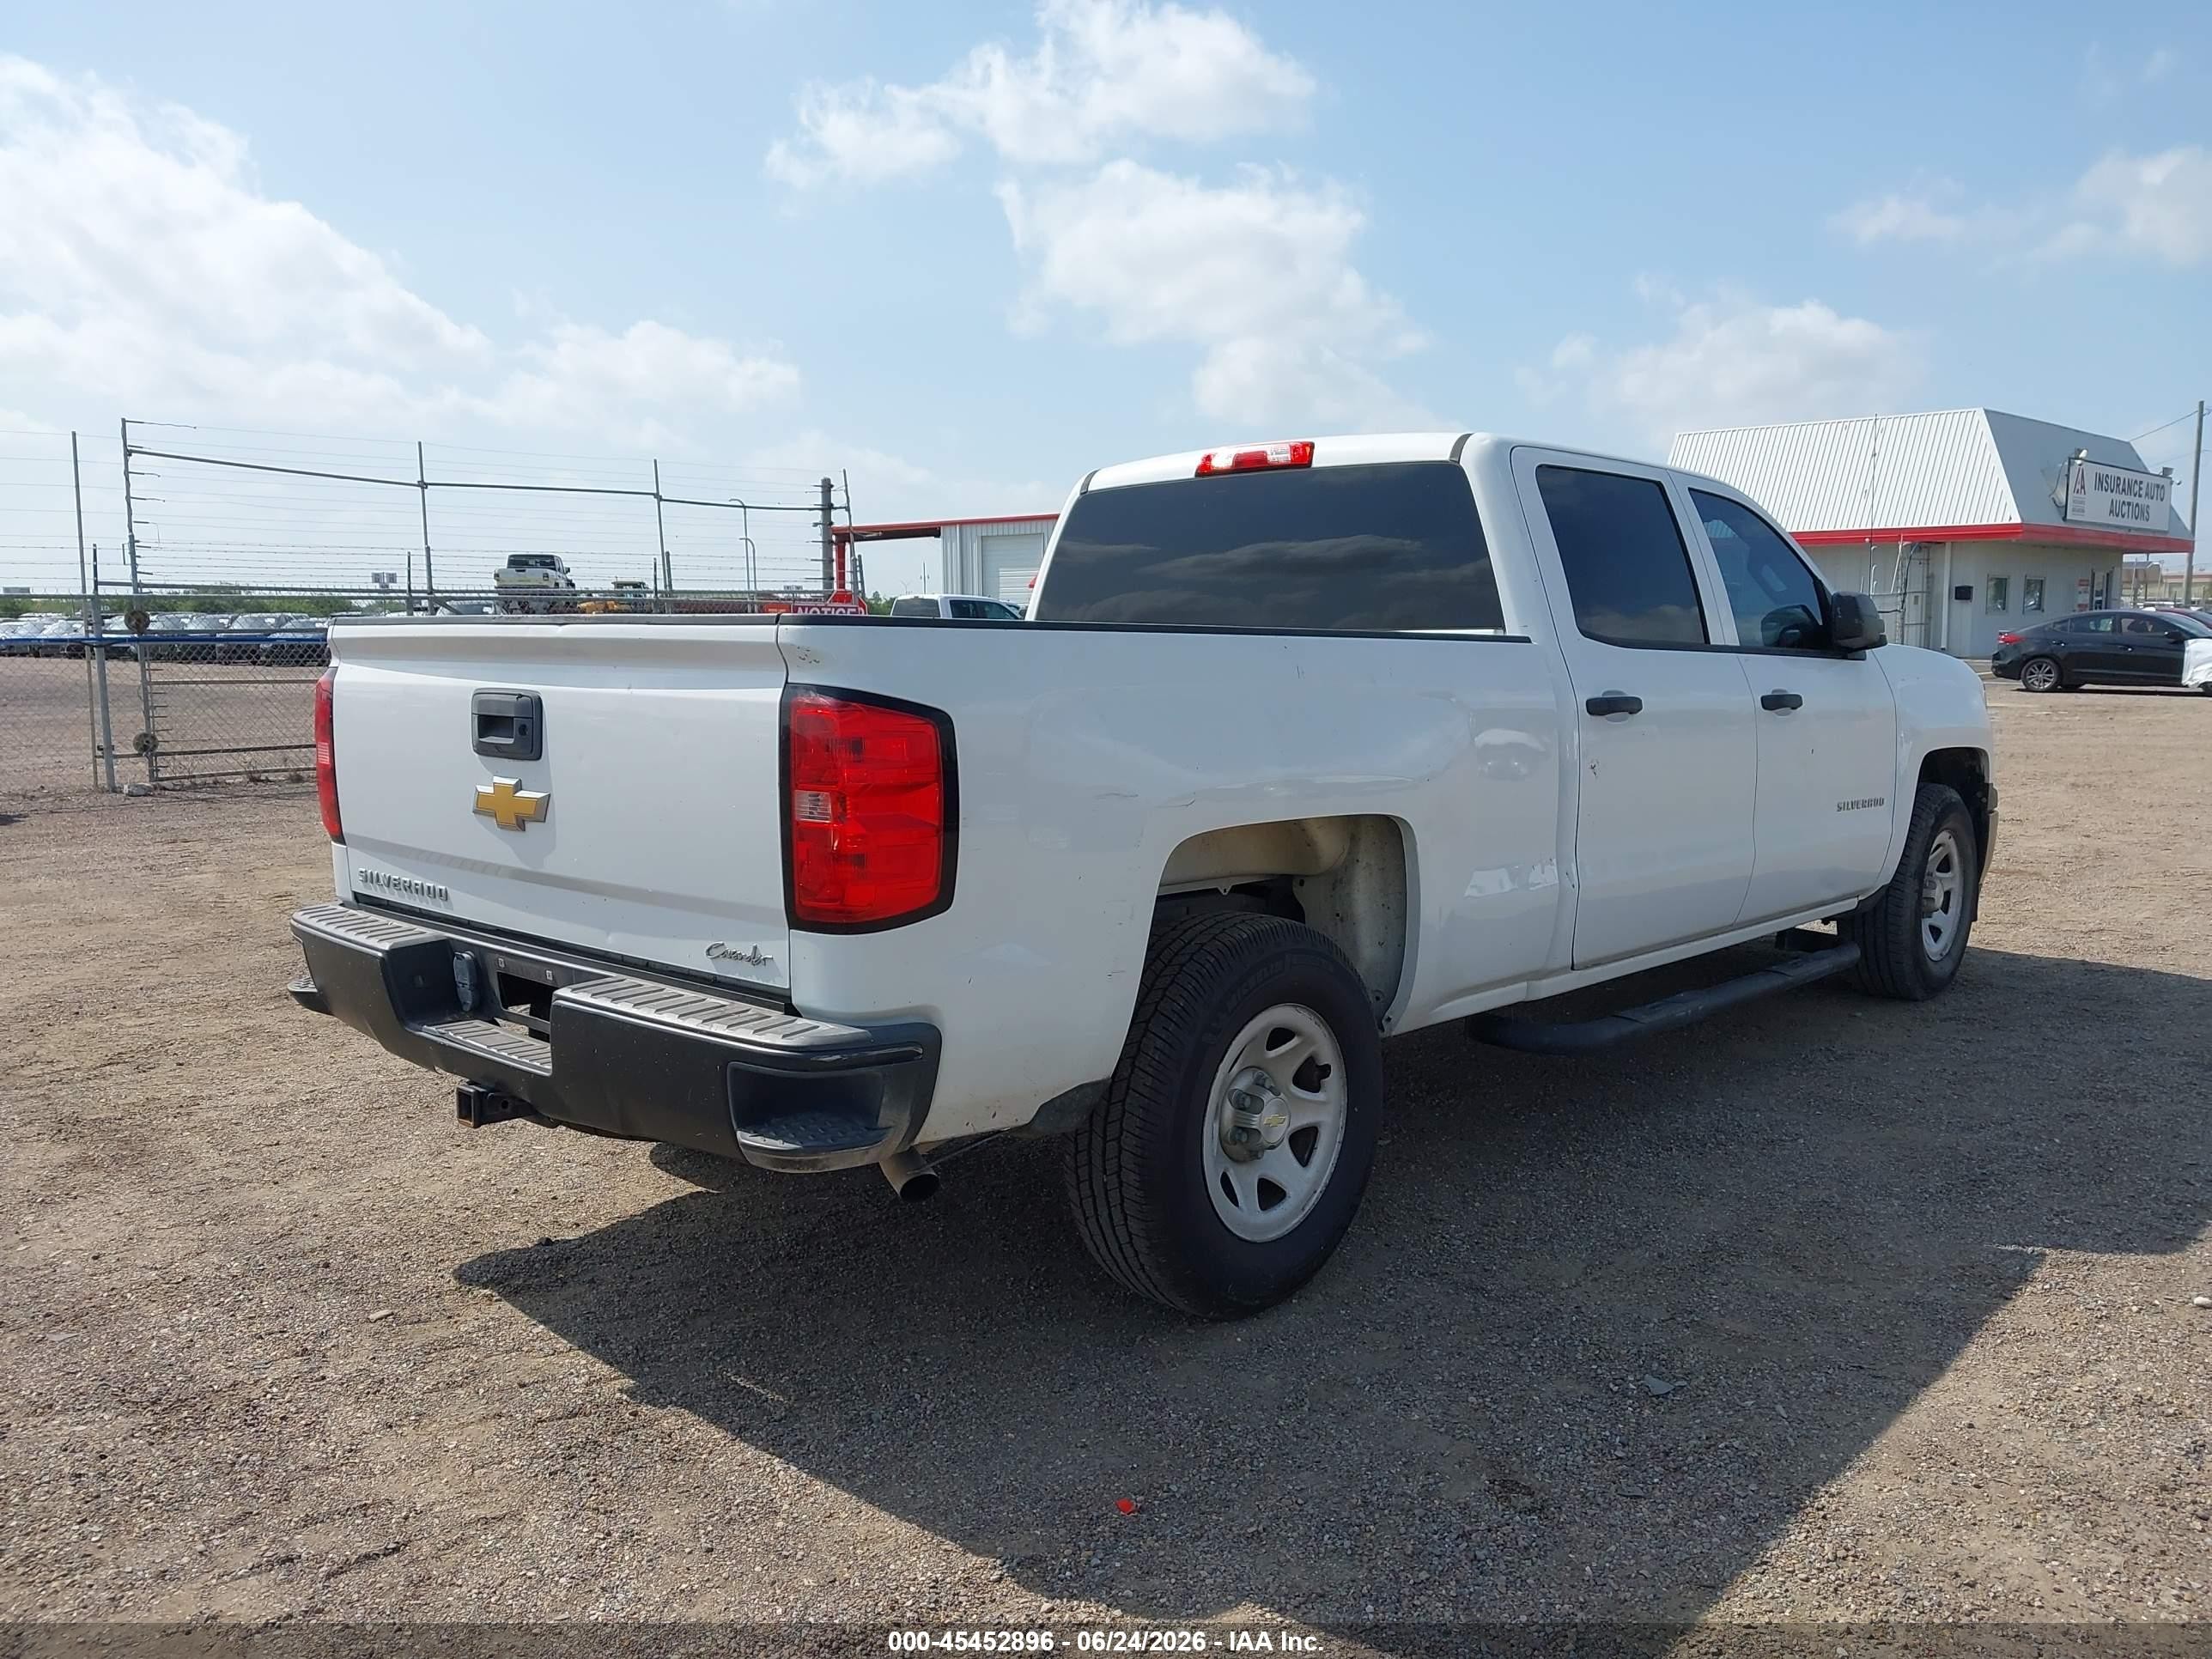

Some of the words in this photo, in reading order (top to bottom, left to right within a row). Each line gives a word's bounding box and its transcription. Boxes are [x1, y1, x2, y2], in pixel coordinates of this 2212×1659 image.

[2094, 471, 2143, 498] INSURANCE
[2144, 483, 2166, 502] AUTO
[2108, 499, 2150, 522] AUCTIONS
[357, 867, 448, 902] SILVERADO
